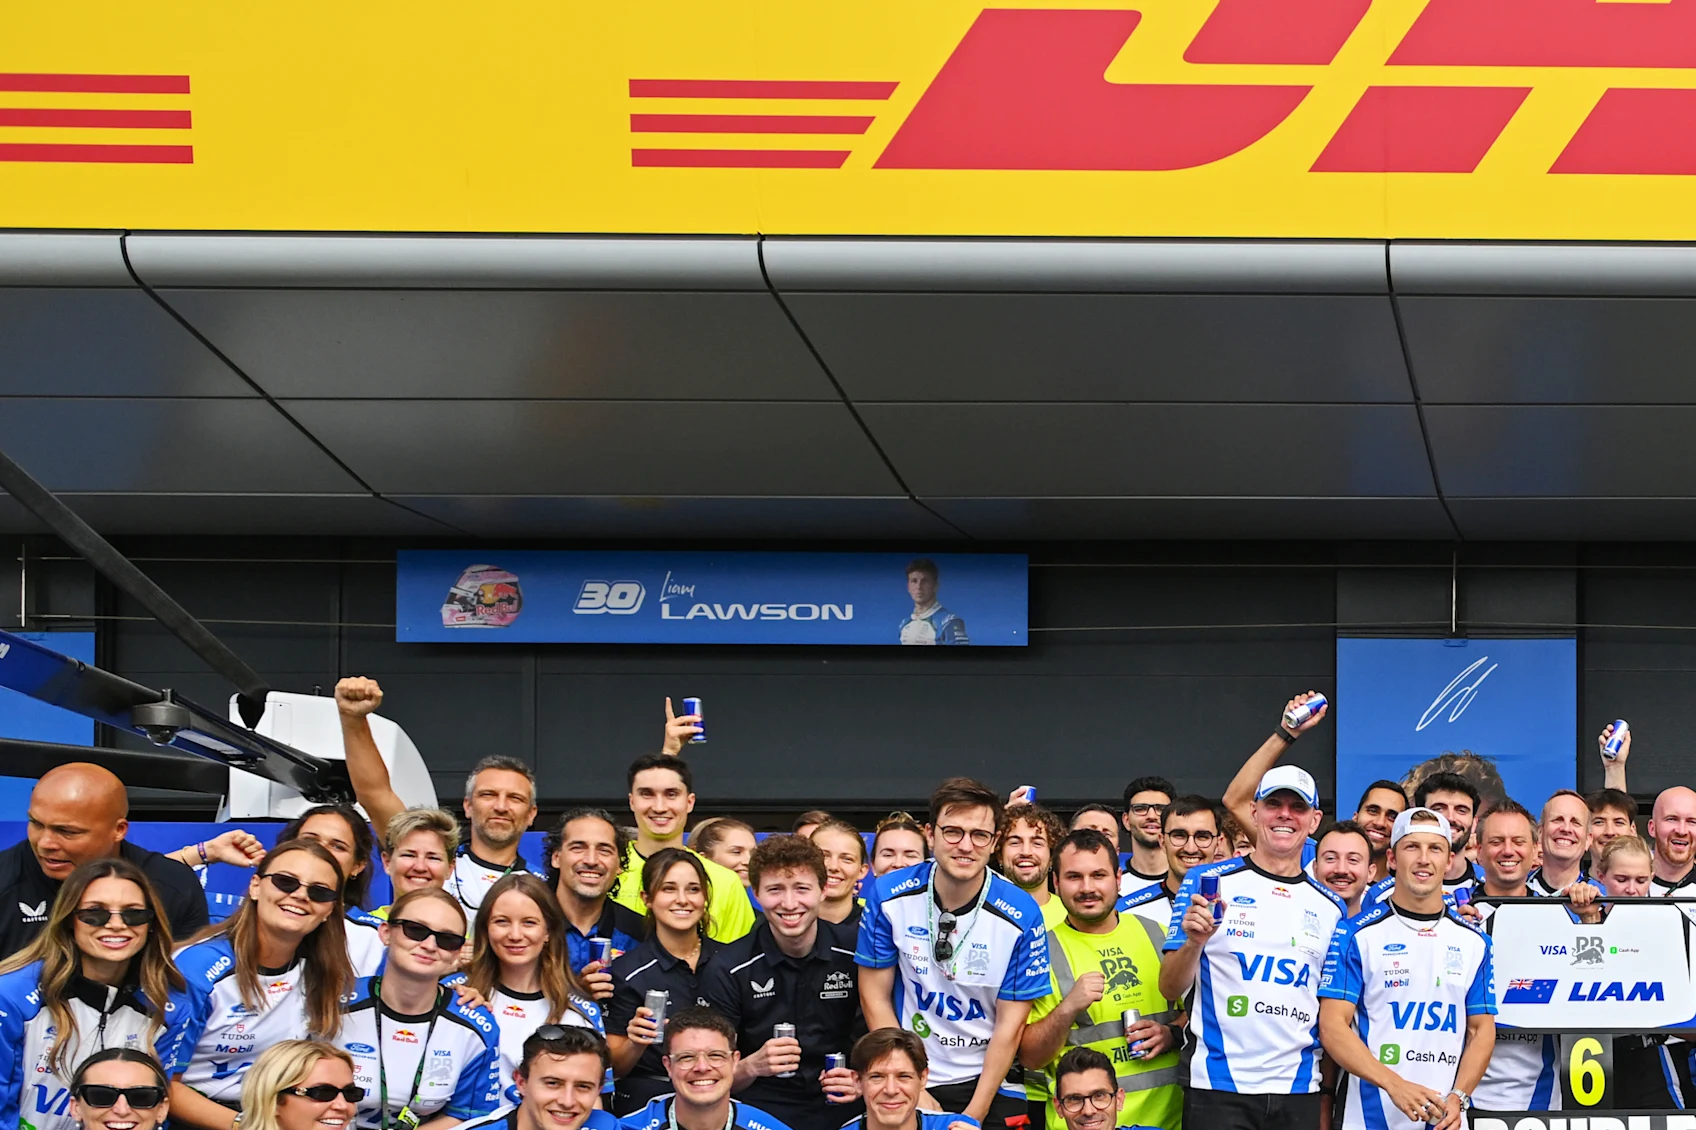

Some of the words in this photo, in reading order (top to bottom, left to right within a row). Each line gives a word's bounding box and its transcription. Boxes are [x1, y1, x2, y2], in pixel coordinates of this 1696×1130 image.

[659, 571, 696, 601] Liam
[573, 580, 646, 615] 30
[661, 603, 853, 620] LAWSON
[891, 878, 920, 894] HUGO
[1313, 882, 1341, 902] HUGO
[1125, 892, 1152, 906] HUGO
[994, 899, 1022, 919] HUGO
[1304, 909, 1318, 918] VISA
[1228, 919, 1255, 927] TUDOR
[1355, 909, 1382, 926] HUGO
[1455, 915, 1483, 933] HUGO
[1226, 928, 1255, 939] Mobil
[1097, 947, 1124, 957] VISA
[1538, 945, 1567, 955] VISA
[205, 956, 231, 982] HUGO
[1229, 951, 1310, 990] VISA
[1384, 968, 1410, 976] TUDOR
[824, 982, 838, 990] Red
[839, 979, 853, 989] Bull
[1384, 979, 1410, 988] Mobil
[1568, 981, 1665, 1002] LIAM
[909, 978, 987, 1022] VISA
[459, 1006, 492, 1032] HUGO
[514, 1011, 526, 1019] Bull
[1254, 1001, 1289, 1017] Cash
[1290, 1005, 1310, 1023] App
[1387, 1001, 1457, 1033] VISA
[221, 1032, 256, 1040] TUDOR
[405, 1036, 418, 1044] Bull
[215, 1044, 253, 1054] Mobil
[1406, 1050, 1435, 1062] Cash
[1437, 1051, 1457, 1066] App
[1568, 1037, 1606, 1107] 6
